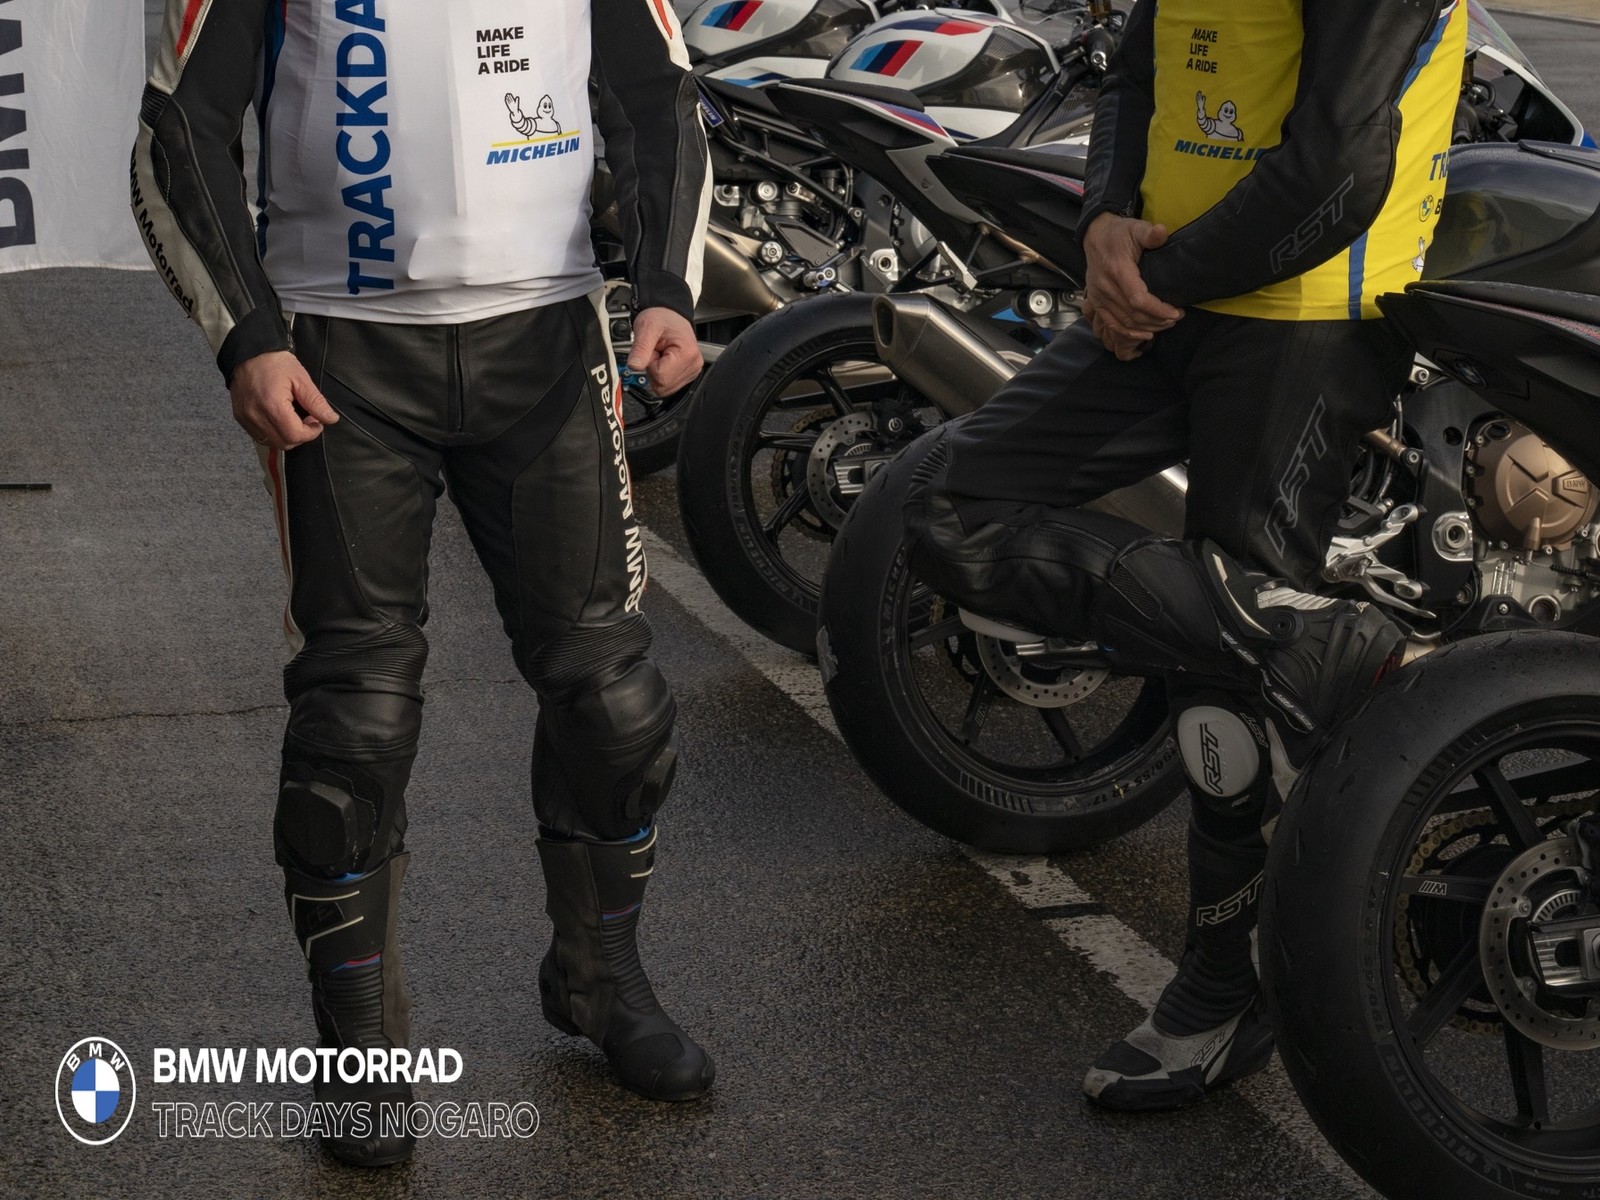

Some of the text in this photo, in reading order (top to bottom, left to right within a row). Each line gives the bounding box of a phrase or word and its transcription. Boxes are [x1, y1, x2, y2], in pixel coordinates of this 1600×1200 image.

[476, 26, 525, 43] MAKE
[1191, 28, 1218, 44] MAKE
[477, 43, 511, 59] LIFE
[1189, 42, 1209, 57] LIFE
[478, 58, 530, 75] A RIDE
[1186, 58, 1218, 74] A RIDE
[486, 136, 580, 165] MICHELIN
[1269, 172, 1354, 275] RST
[139, 208, 194, 314] Motorrad
[1264, 394, 1327, 560] RST
[1566, 480, 1586, 488] BMW
[624, 525, 642, 613] BMW
[1200, 723, 1223, 794] RST
[1196, 869, 1264, 927] RST
[1384, 1053, 1479, 1165] MICHELIN
